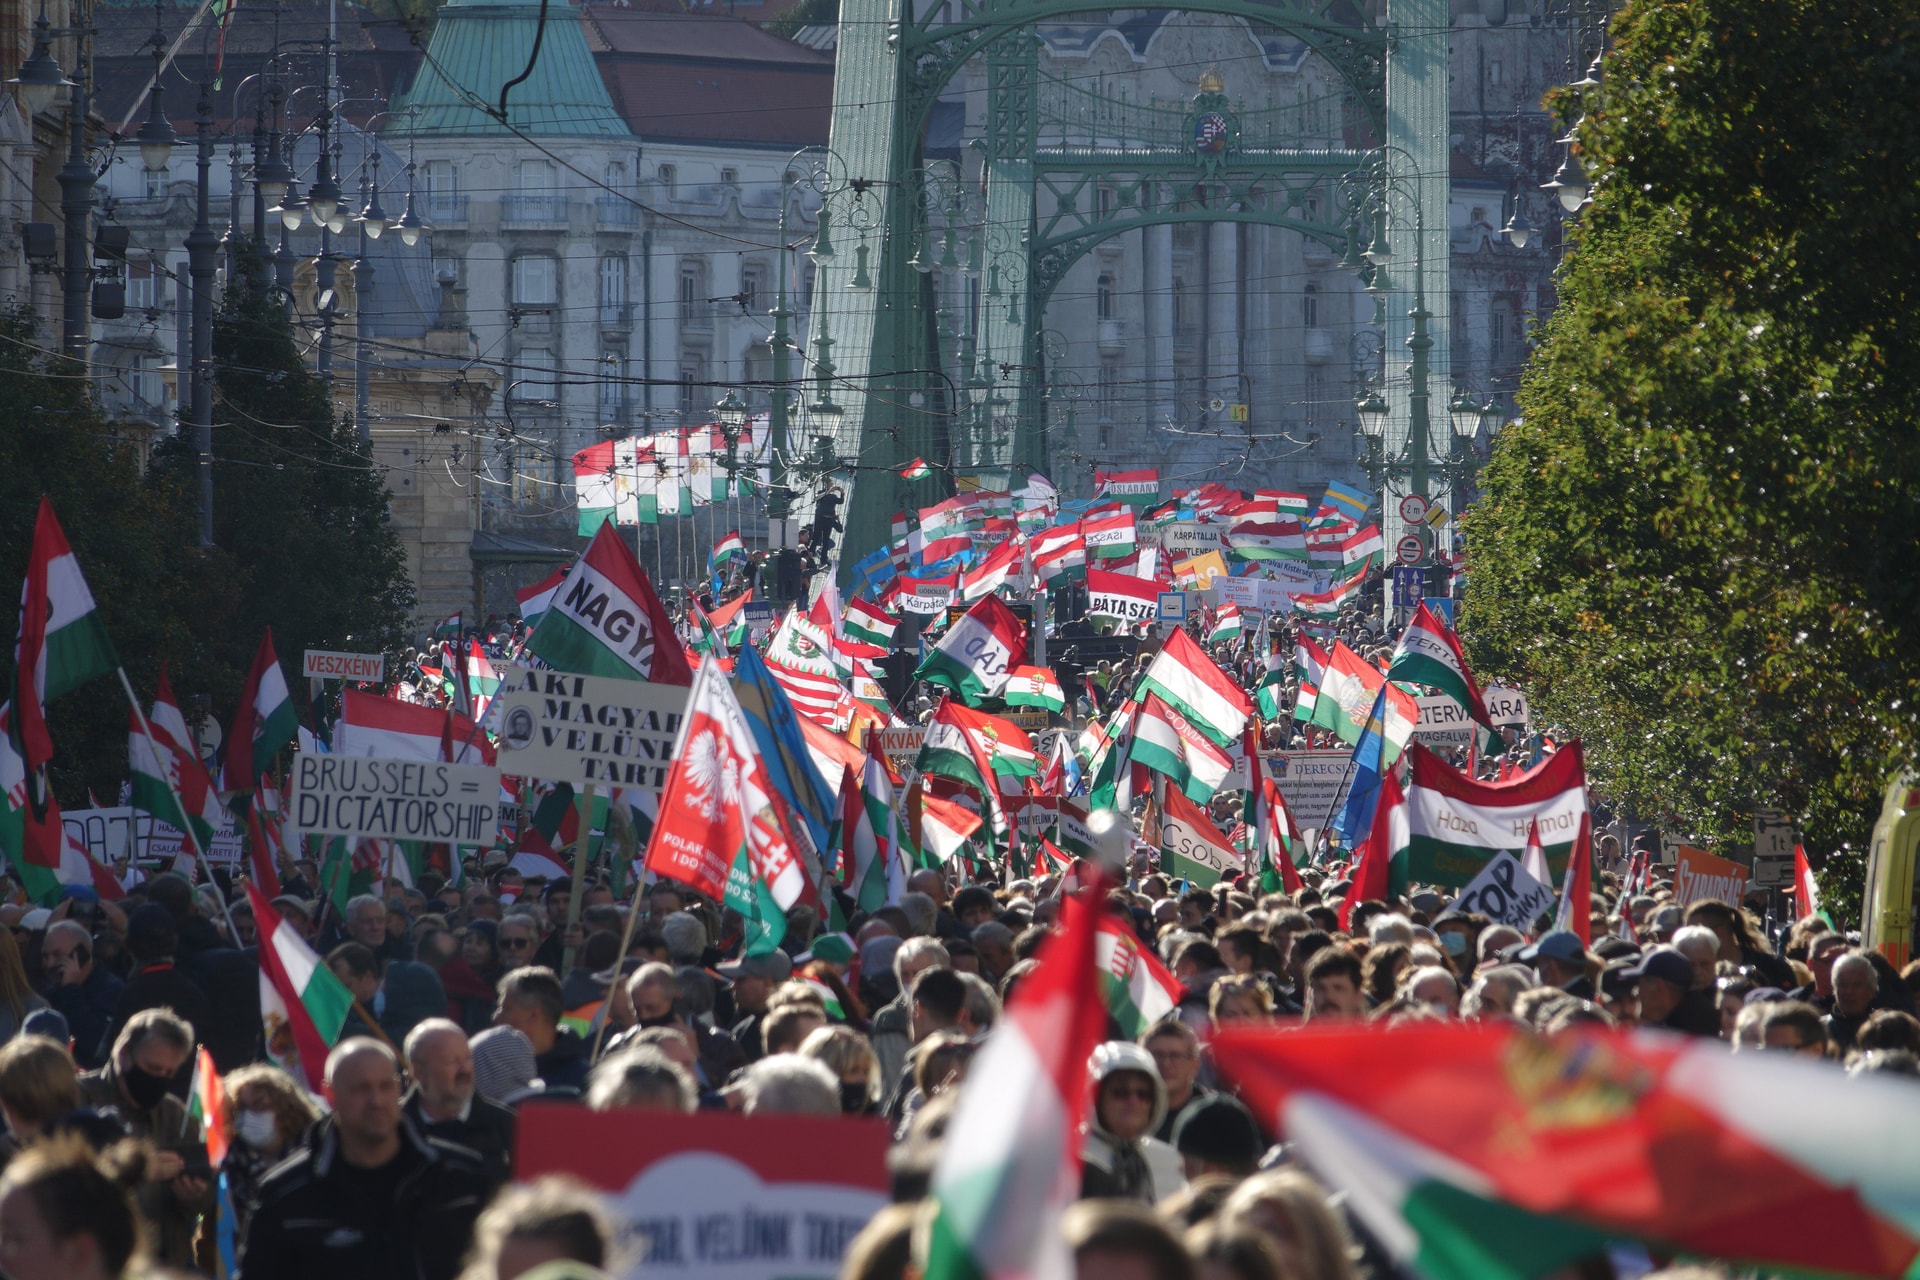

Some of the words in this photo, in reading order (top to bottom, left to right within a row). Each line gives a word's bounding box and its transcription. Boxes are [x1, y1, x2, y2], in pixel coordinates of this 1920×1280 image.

[1406, 505, 1411, 514] 2
[1413, 507, 1420, 515] m
[1093, 595, 1158, 619] BÁTASZÉ
[565, 576, 655, 667] NAGY
[307, 654, 382, 677] VESZKÉNY
[301, 756, 449, 797] BRUSSELS
[298, 793, 494, 841] DICTATORSHIP
[1438, 809, 1479, 835] Haza
[1514, 810, 1575, 836] Hemat
